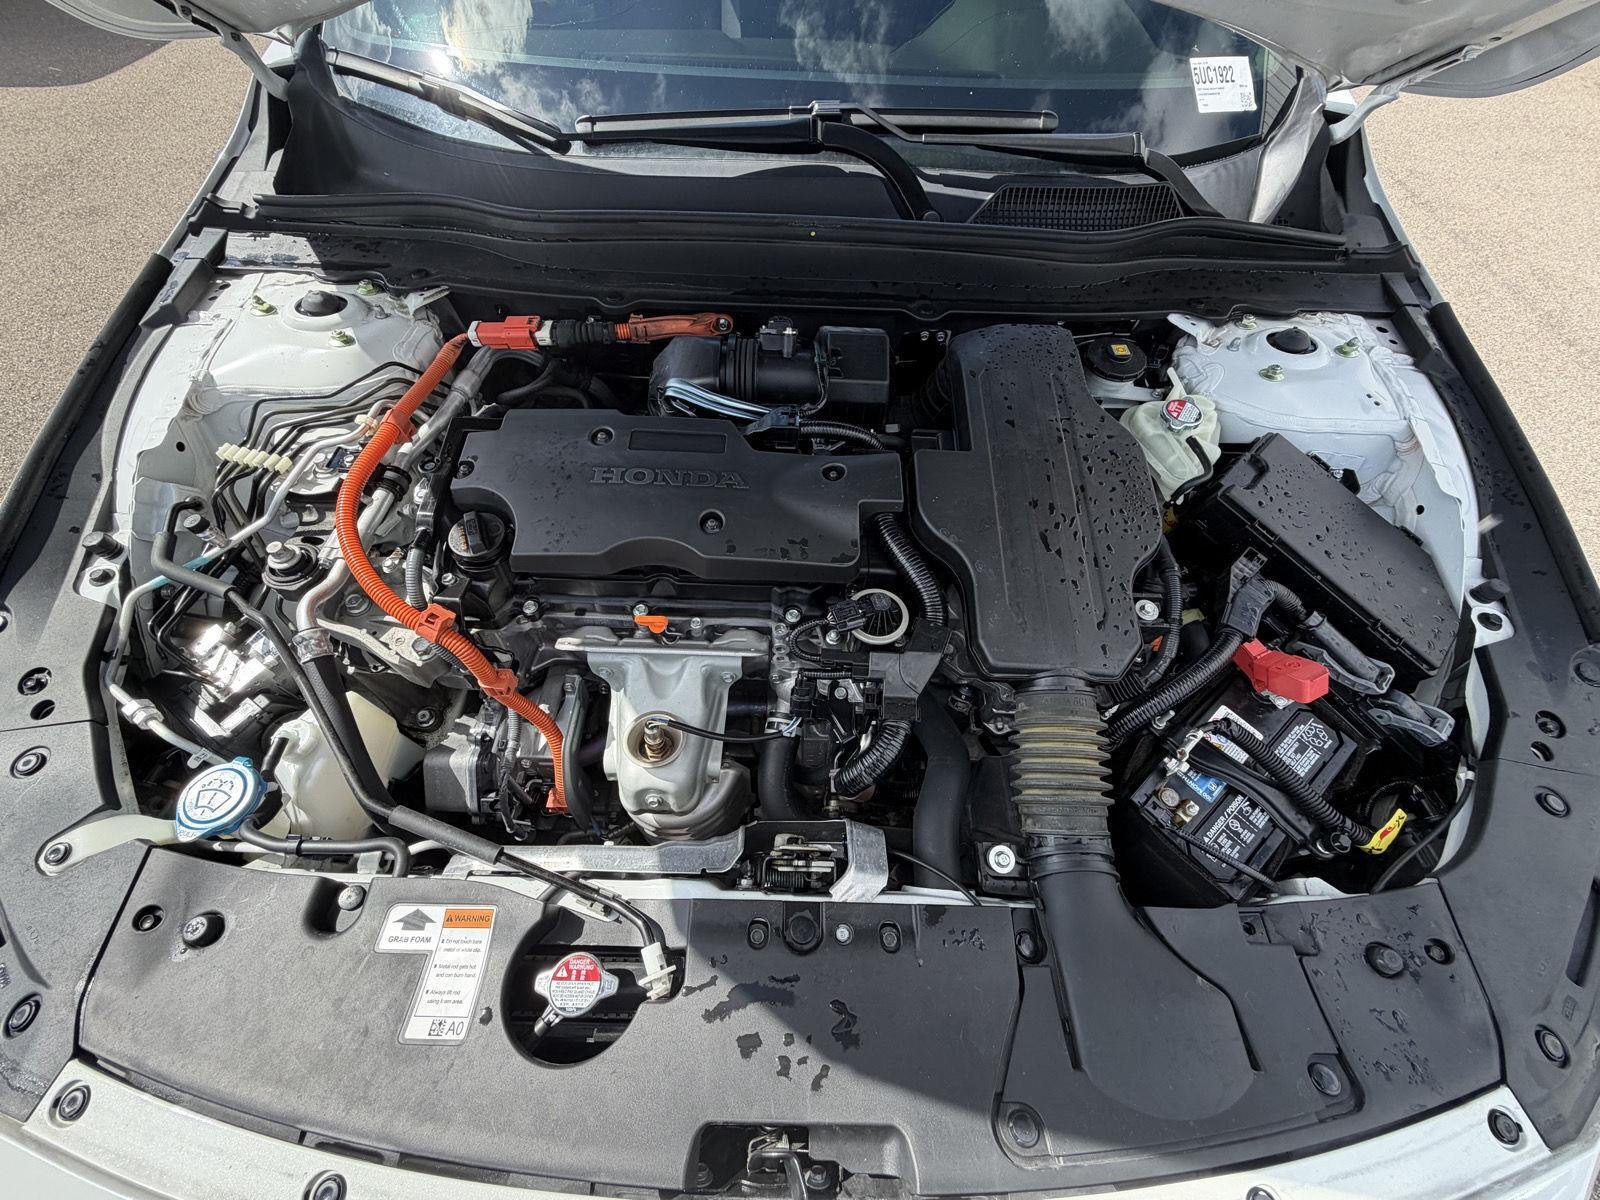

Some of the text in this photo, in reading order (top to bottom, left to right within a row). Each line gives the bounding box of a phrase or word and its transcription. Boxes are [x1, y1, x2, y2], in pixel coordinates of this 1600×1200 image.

[1193, 65, 1235, 85] 5UC1922
[590, 466, 750, 489] HONDA
[1206, 815, 1226, 837] DANGER
[1226, 794, 1244, 815] POISON
[454, 914, 491, 923] WARNING
[388, 936, 432, 944] GRAB FOAM
[445, 1020, 465, 1036] A0
